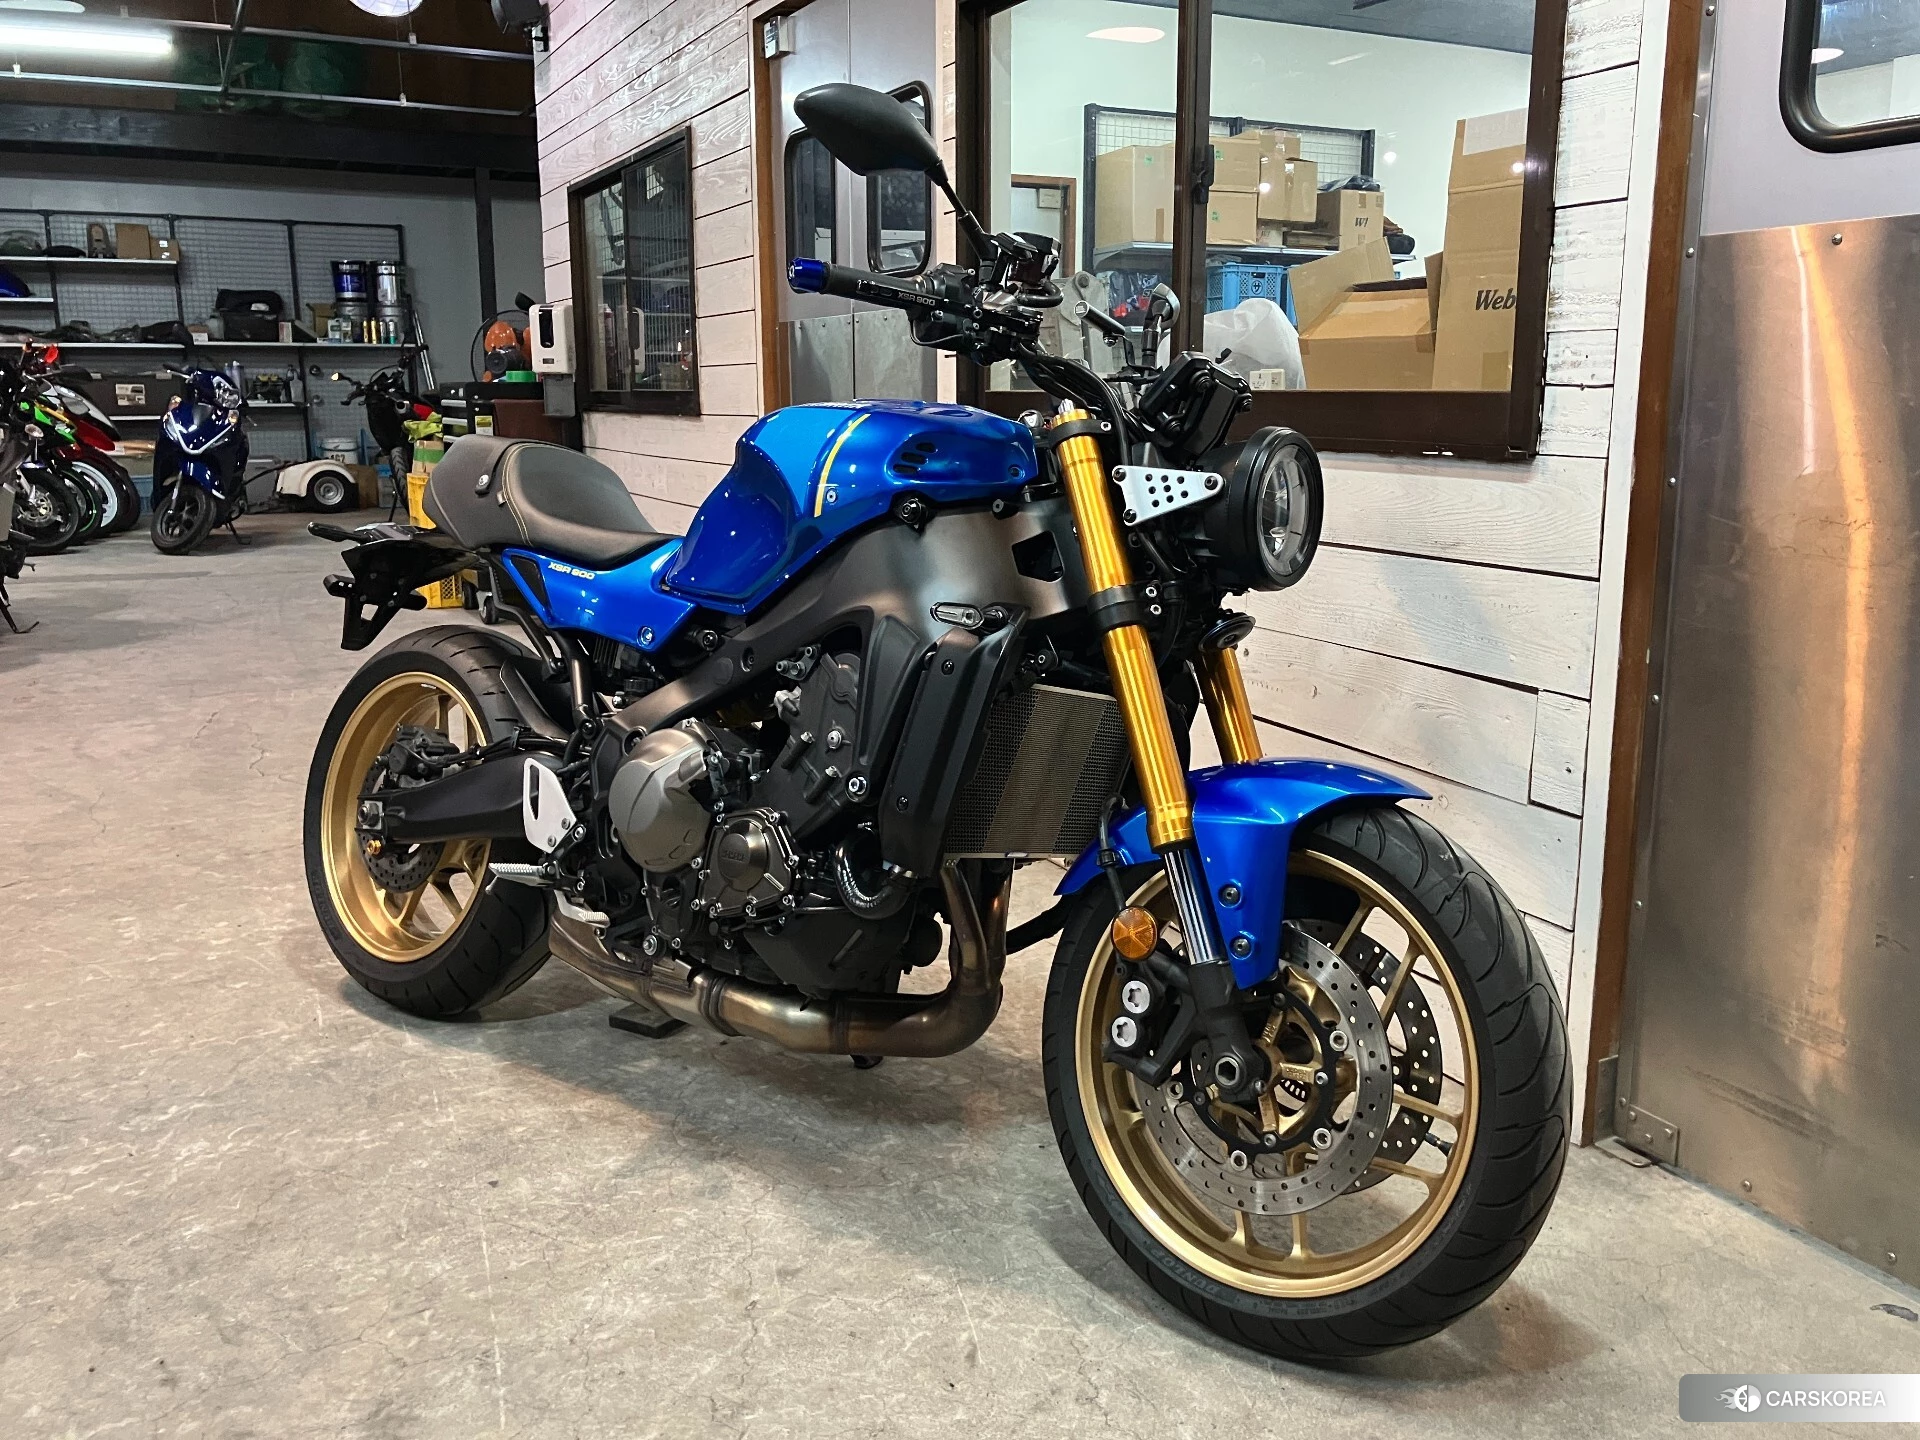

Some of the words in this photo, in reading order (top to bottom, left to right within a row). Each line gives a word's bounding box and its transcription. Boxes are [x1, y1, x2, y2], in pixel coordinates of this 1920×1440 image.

[898, 291, 916, 302] XSR
[916, 296, 936, 306] 900
[1150, 1245, 1223, 1295] DUNLOP
